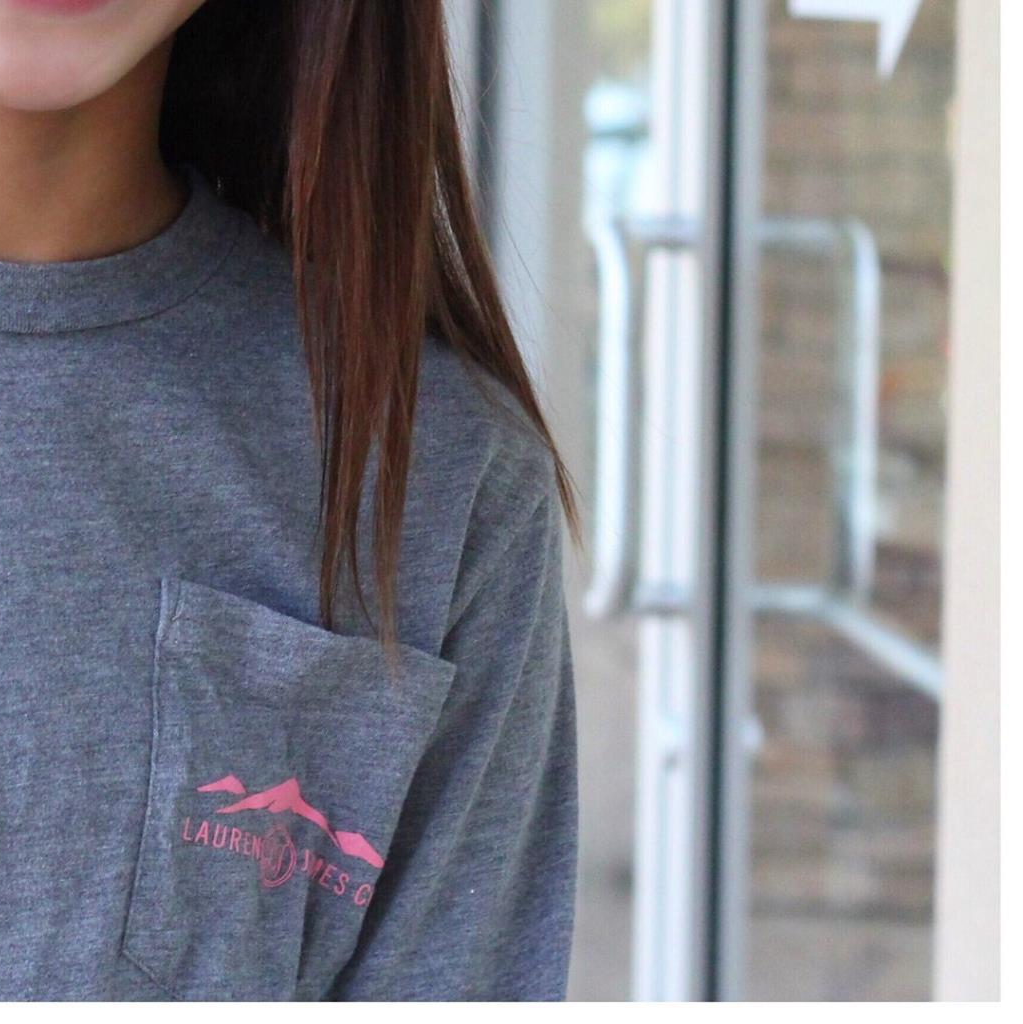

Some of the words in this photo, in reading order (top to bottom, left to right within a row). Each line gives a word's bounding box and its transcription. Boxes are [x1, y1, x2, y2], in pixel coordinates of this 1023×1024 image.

[182, 817, 262, 860] LAUREN
[300, 848, 350, 896] JMES
[353, 882, 377, 907] C
